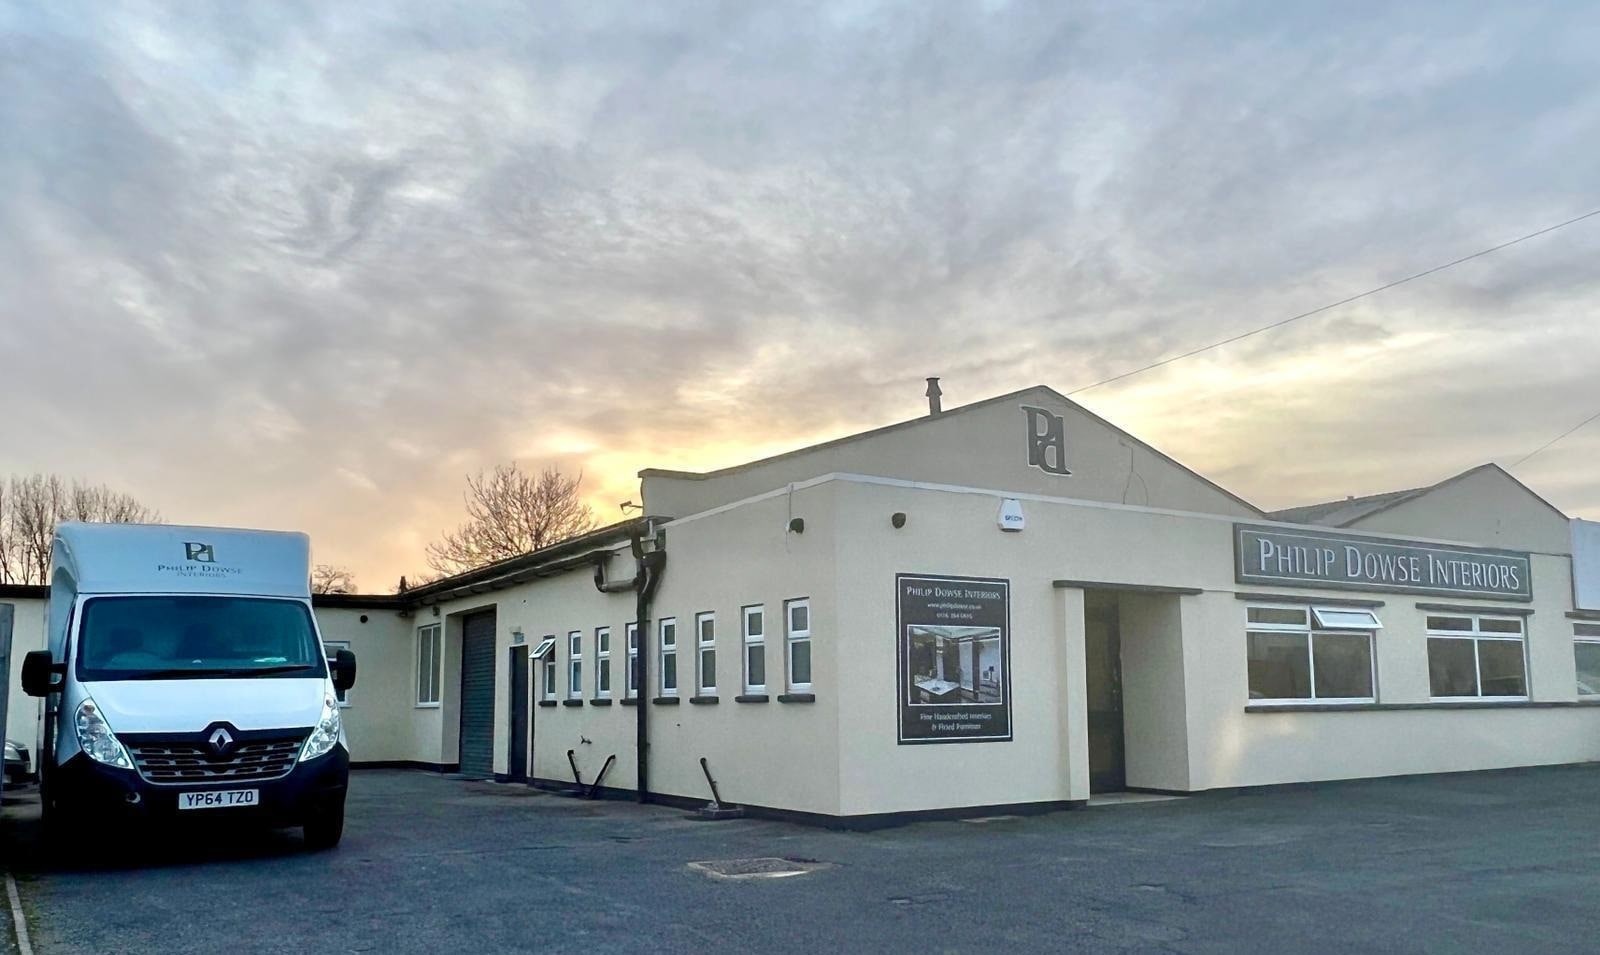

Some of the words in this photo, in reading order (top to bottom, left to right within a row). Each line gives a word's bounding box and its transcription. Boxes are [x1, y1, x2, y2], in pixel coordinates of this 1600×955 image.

[157, 564, 197, 572] PHILIP
[202, 565, 243, 575] DOWSE
[1257, 537, 1336, 577] PHILIP
[1343, 545, 1421, 582] DOWSE
[1427, 554, 1520, 590] INTERIORS
[906, 586, 933, 597] PHILIP
[935, 587, 962, 598] DOWSE
[964, 589, 1001, 600] INTERIORS
[187, 793, 223, 806] YP64
